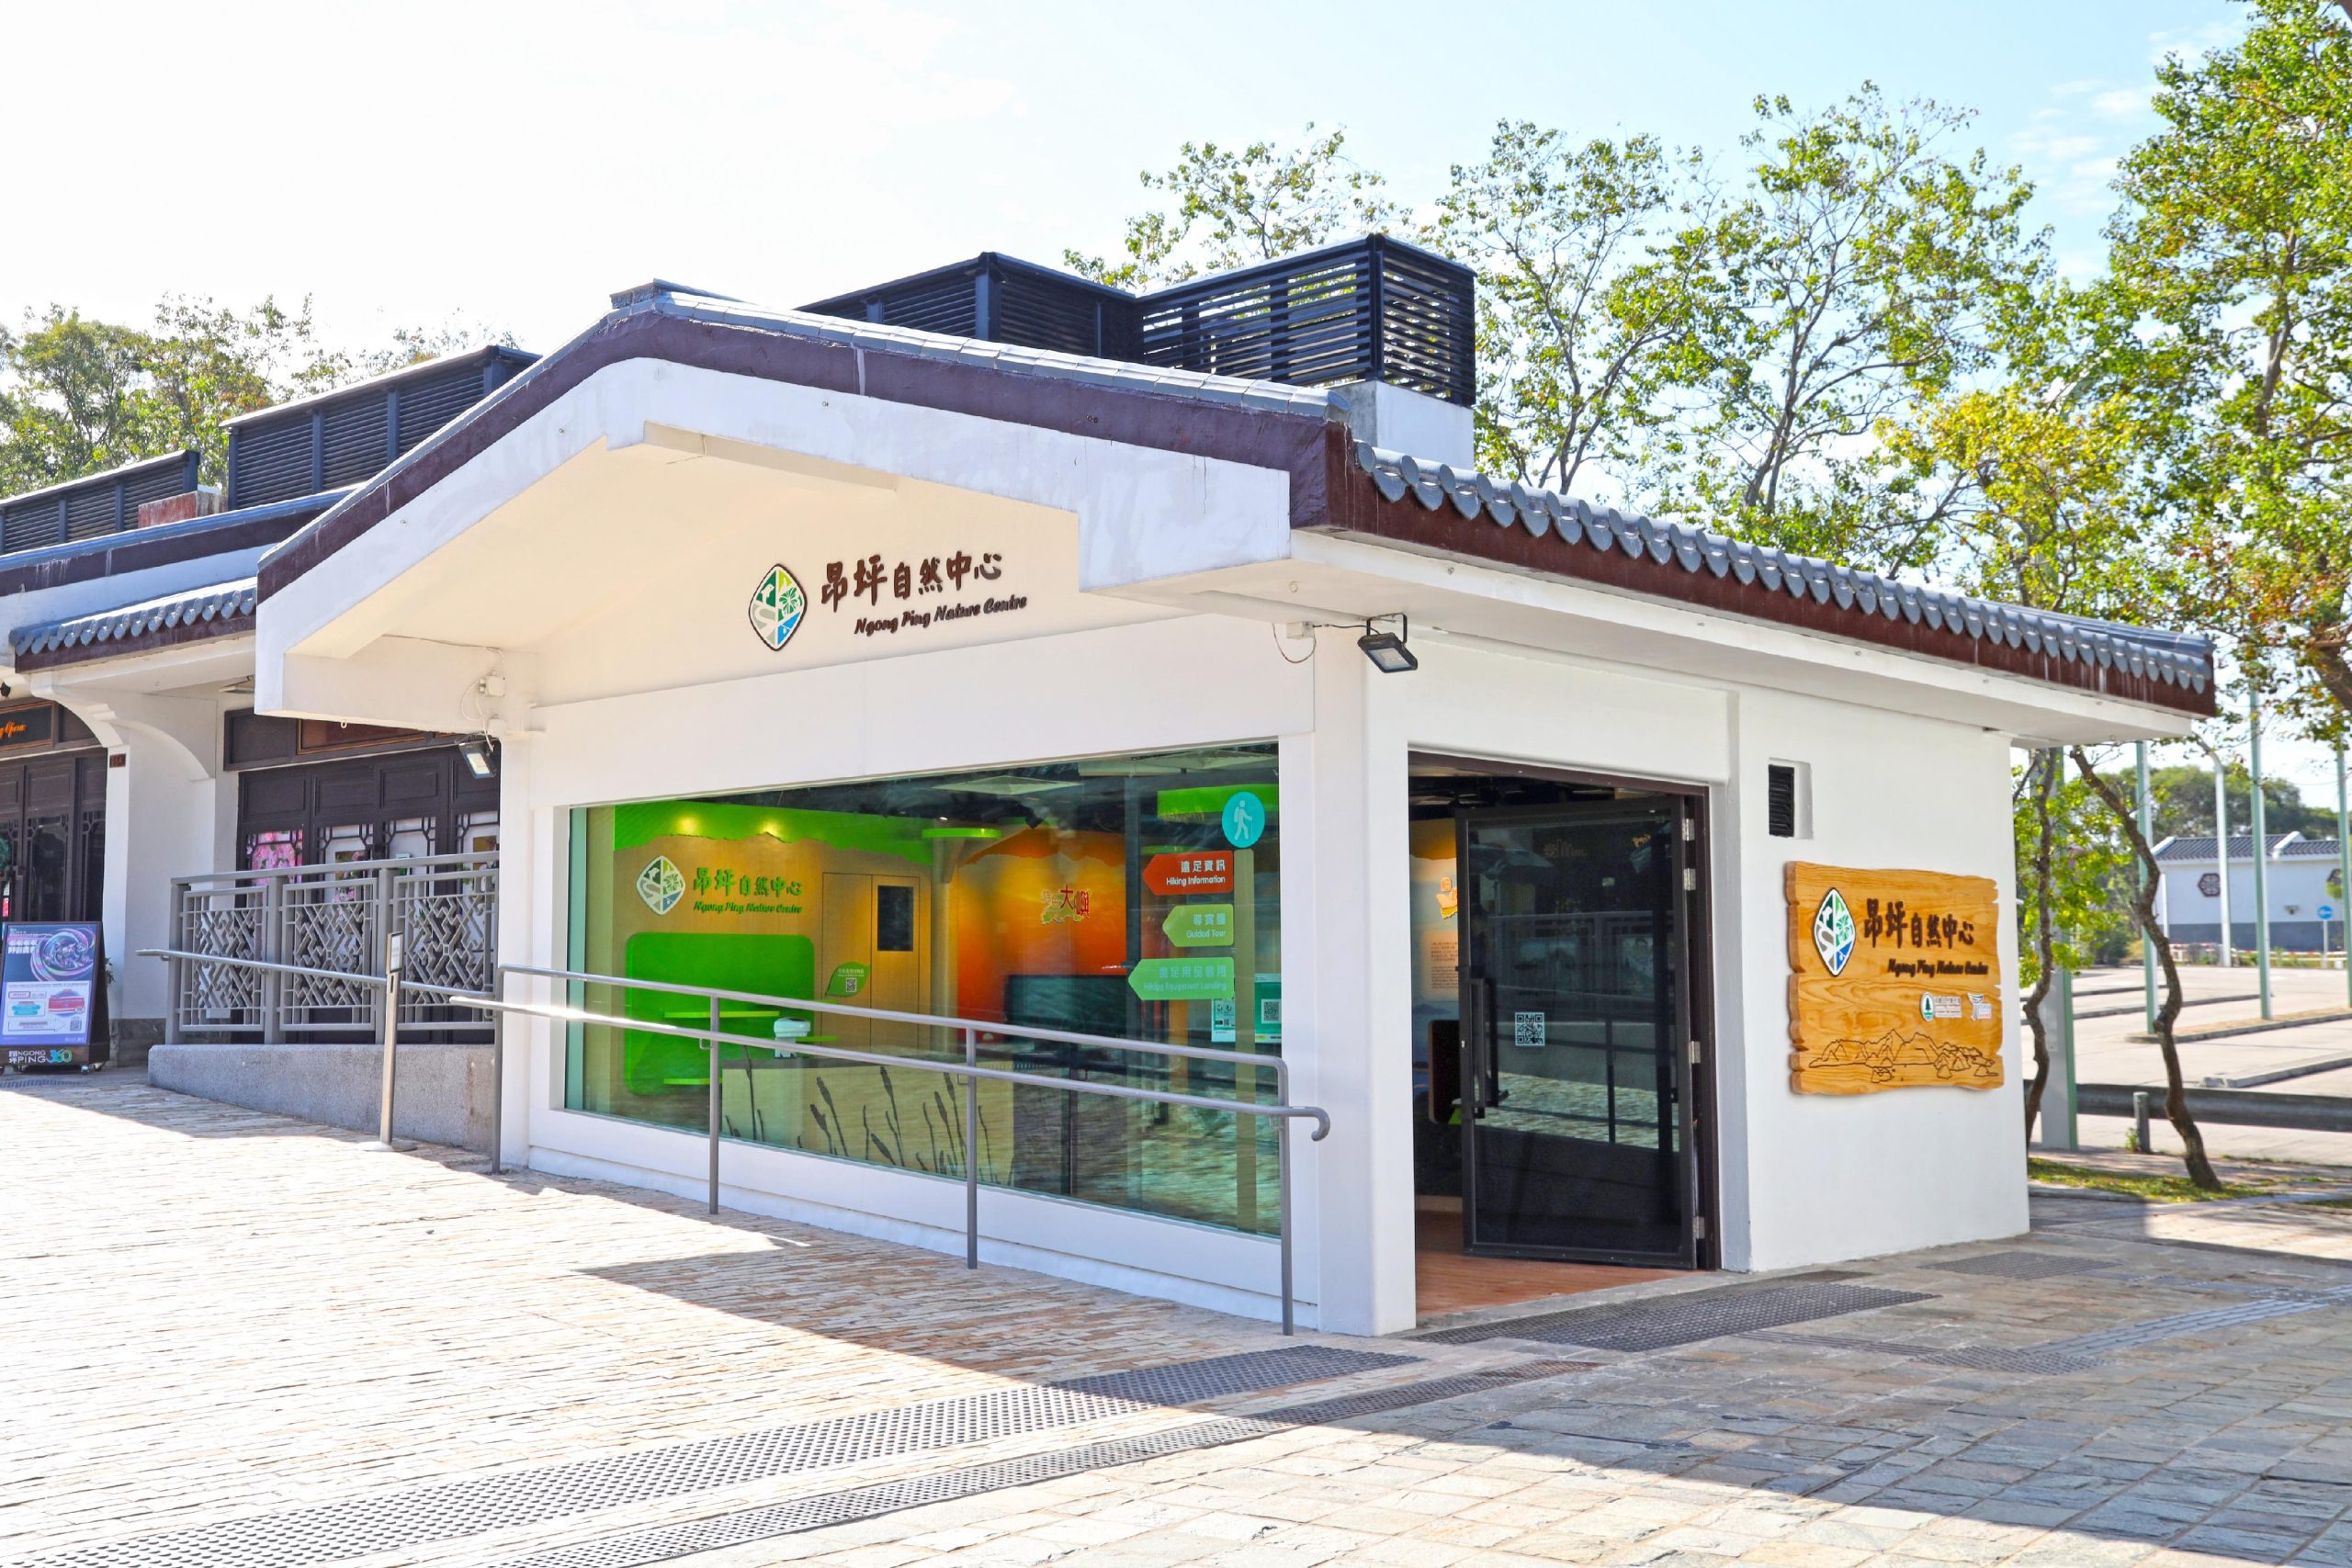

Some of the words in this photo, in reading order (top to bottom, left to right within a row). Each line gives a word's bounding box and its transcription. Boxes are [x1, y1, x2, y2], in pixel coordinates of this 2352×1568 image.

[820, 550, 1002, 613] 昂坪自然中心
[854, 617, 899, 637] Ngong
[900, 610, 931, 628] Ping
[933, 603, 981, 622] Nature
[983, 594, 1027, 615] Centre
[1181, 859, 1226, 873] 遠足資訊
[694, 867, 802, 897] 昂坪自然中心
[1166, 876, 1187, 886] Hiking
[1188, 874, 1226, 885] Information
[694, 901, 724, 914] Ngong
[725, 902, 744, 915] Ping
[745, 903, 775, 913] Nature
[775, 904, 803, 914] Centre
[1864, 897, 1974, 949] 昂坪自然中心
[1186, 930, 1210, 939] Guided
[1211, 929, 1227, 937] Tour
[1887, 958, 1917, 977] Ngong
[18, 1055, 46, 1064] PING
[46, 1048, 73, 1064] 360
